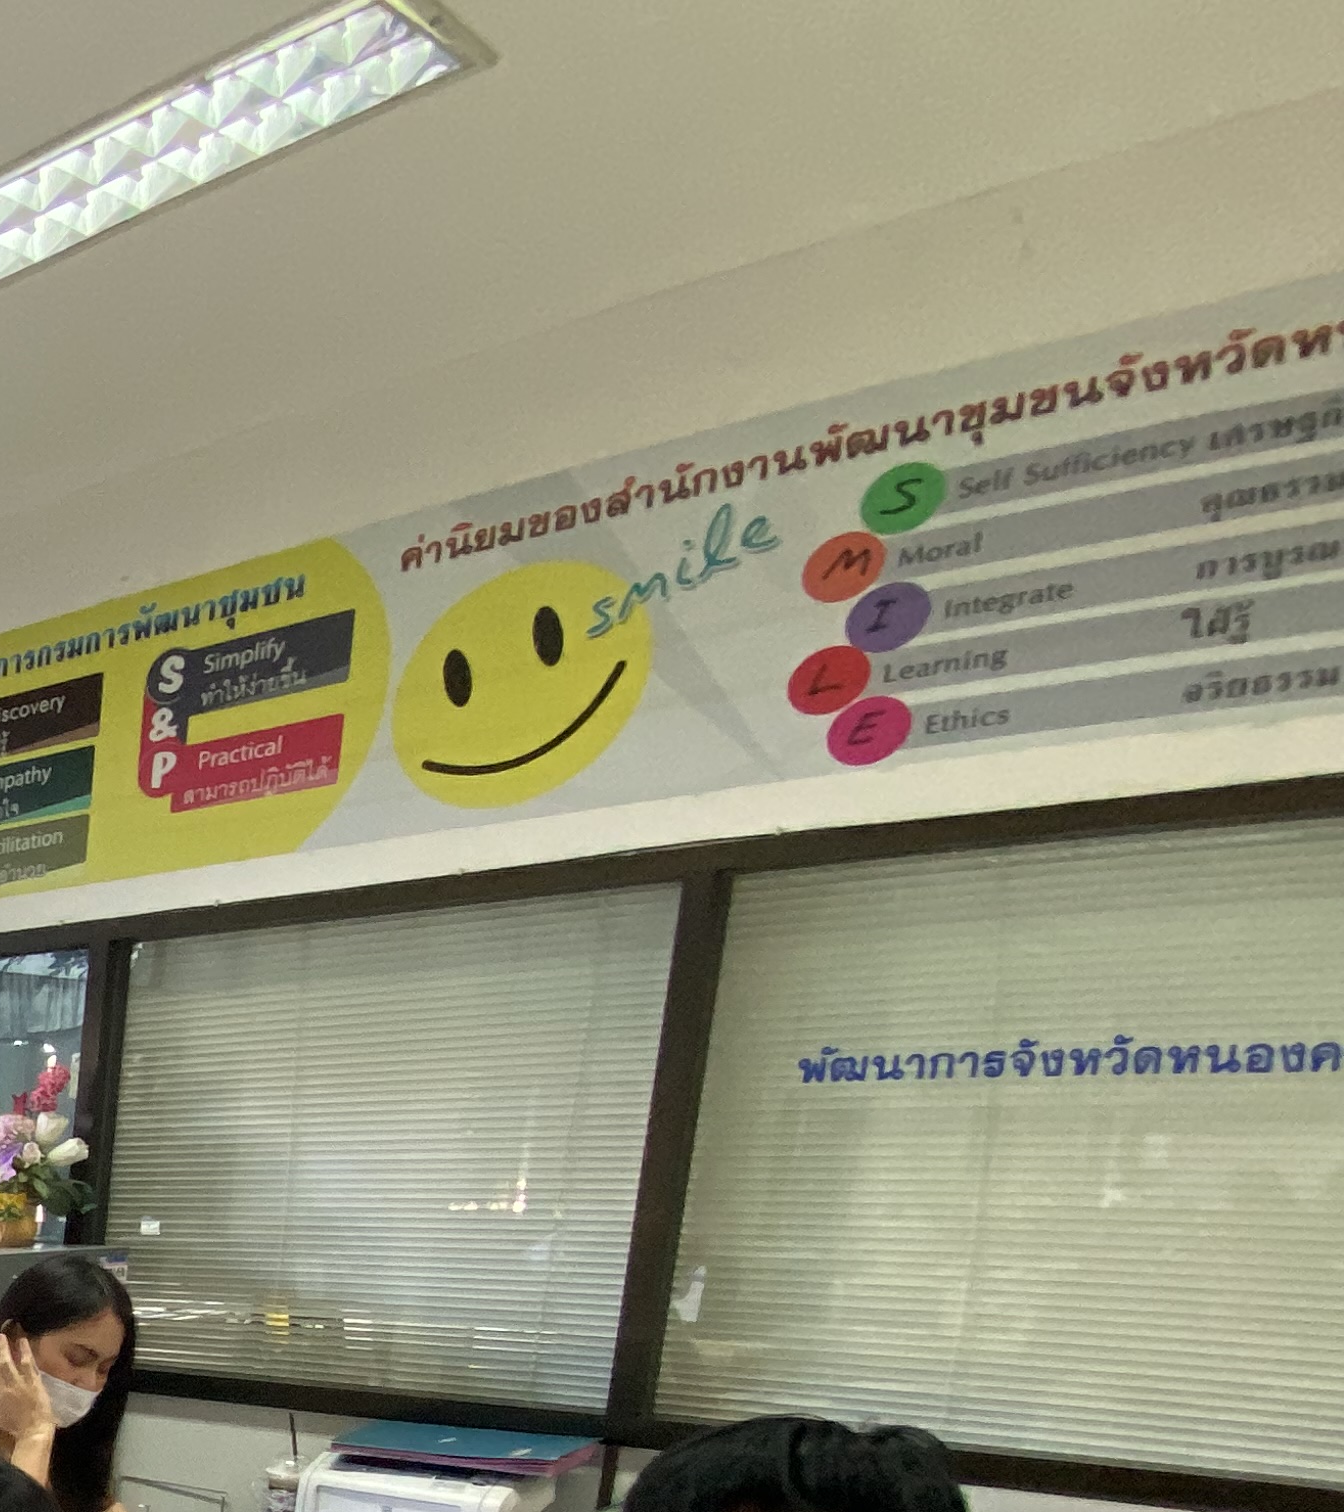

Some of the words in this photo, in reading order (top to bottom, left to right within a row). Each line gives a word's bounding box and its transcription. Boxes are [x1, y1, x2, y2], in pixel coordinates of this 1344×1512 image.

[880, 478, 923, 516] S
[586, 503, 782, 640] smile
[822, 547, 874, 582] M
[898, 531, 985, 569] Moral
[866, 599, 897, 635] I
[944, 580, 1075, 621] Integrate
[158, 655, 185, 694] S
[203, 637, 287, 675] Simplify
[805, 663, 843, 697] L
[883, 647, 1007, 685] Learning
[149, 707, 177, 742] &
[846, 709, 886, 746] E
[924, 706, 1011, 736] Ethics
[151, 751, 177, 788] P
[198, 735, 284, 770] Practical
[798, 1034, 1342, 1084] พัฒนาการจังหวัดหนองค
